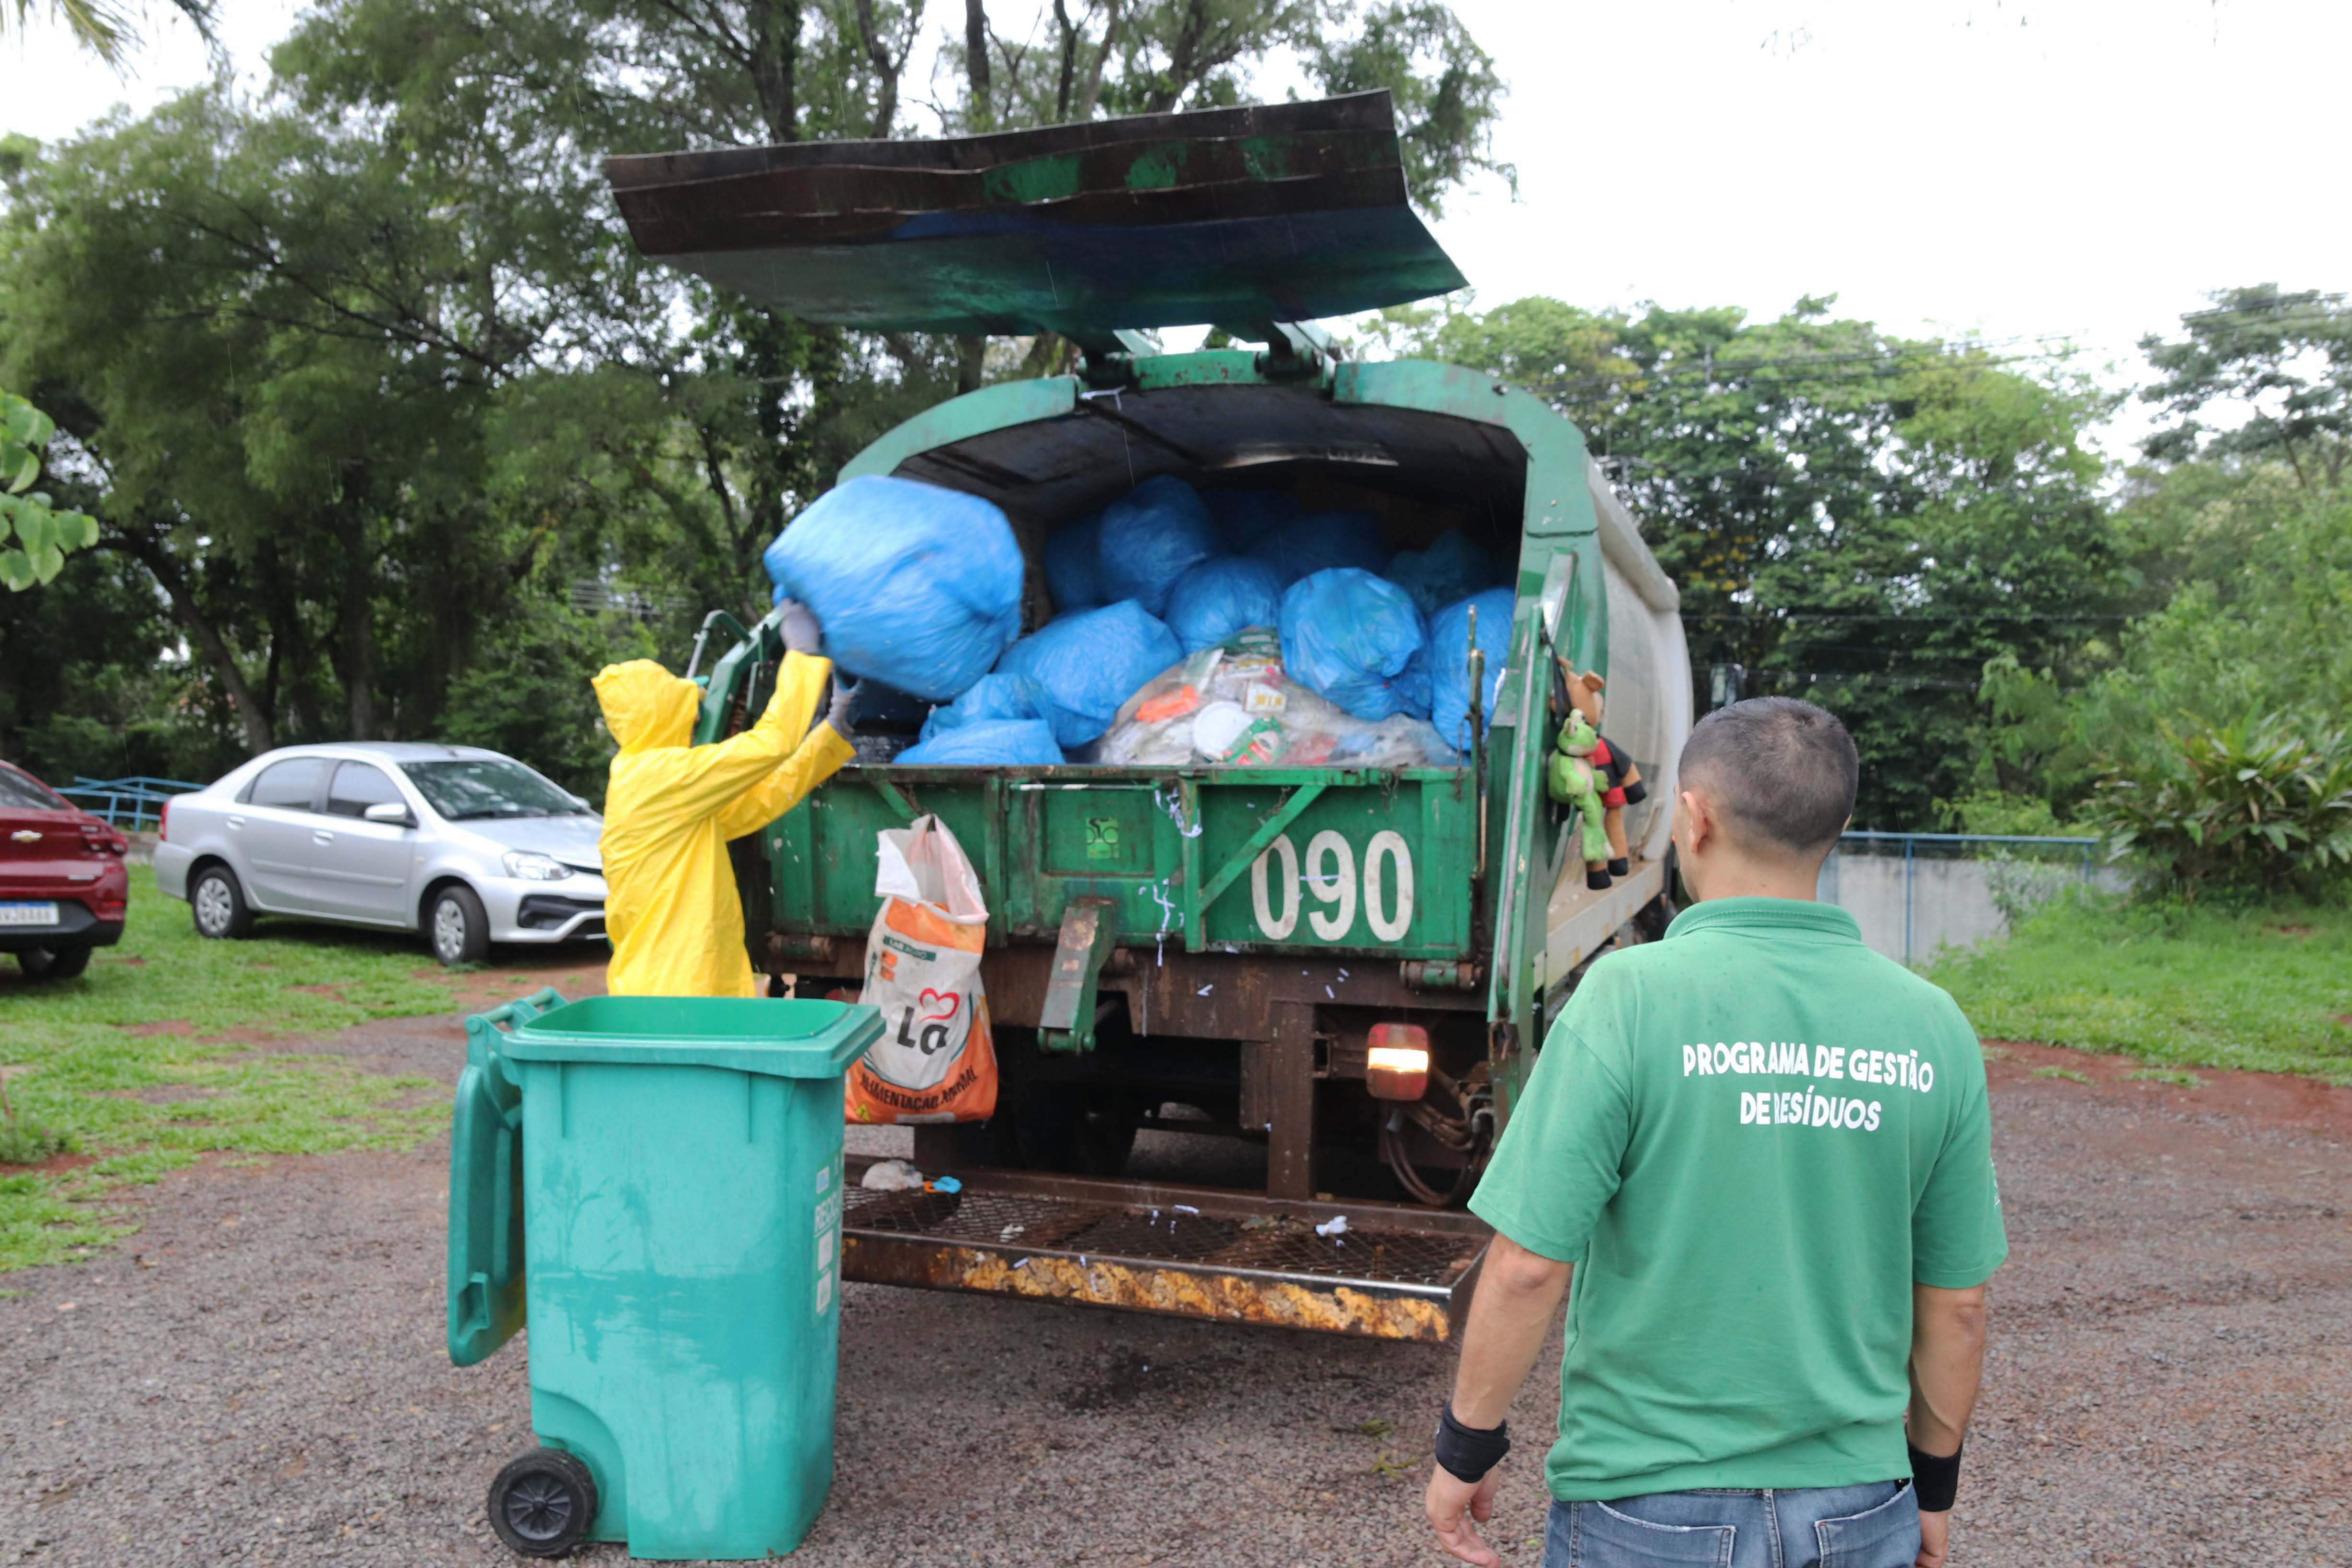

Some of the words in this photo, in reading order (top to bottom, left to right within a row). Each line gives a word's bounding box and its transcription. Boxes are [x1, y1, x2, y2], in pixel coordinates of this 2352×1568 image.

[1251, 830, 1414, 942] 090
[897, 1007, 949, 1055] La
[1683, 1042, 1809, 1076] PROGRAMA
[1813, 1045, 1845, 1079] DE
[1740, 1092, 1771, 1125] DE
